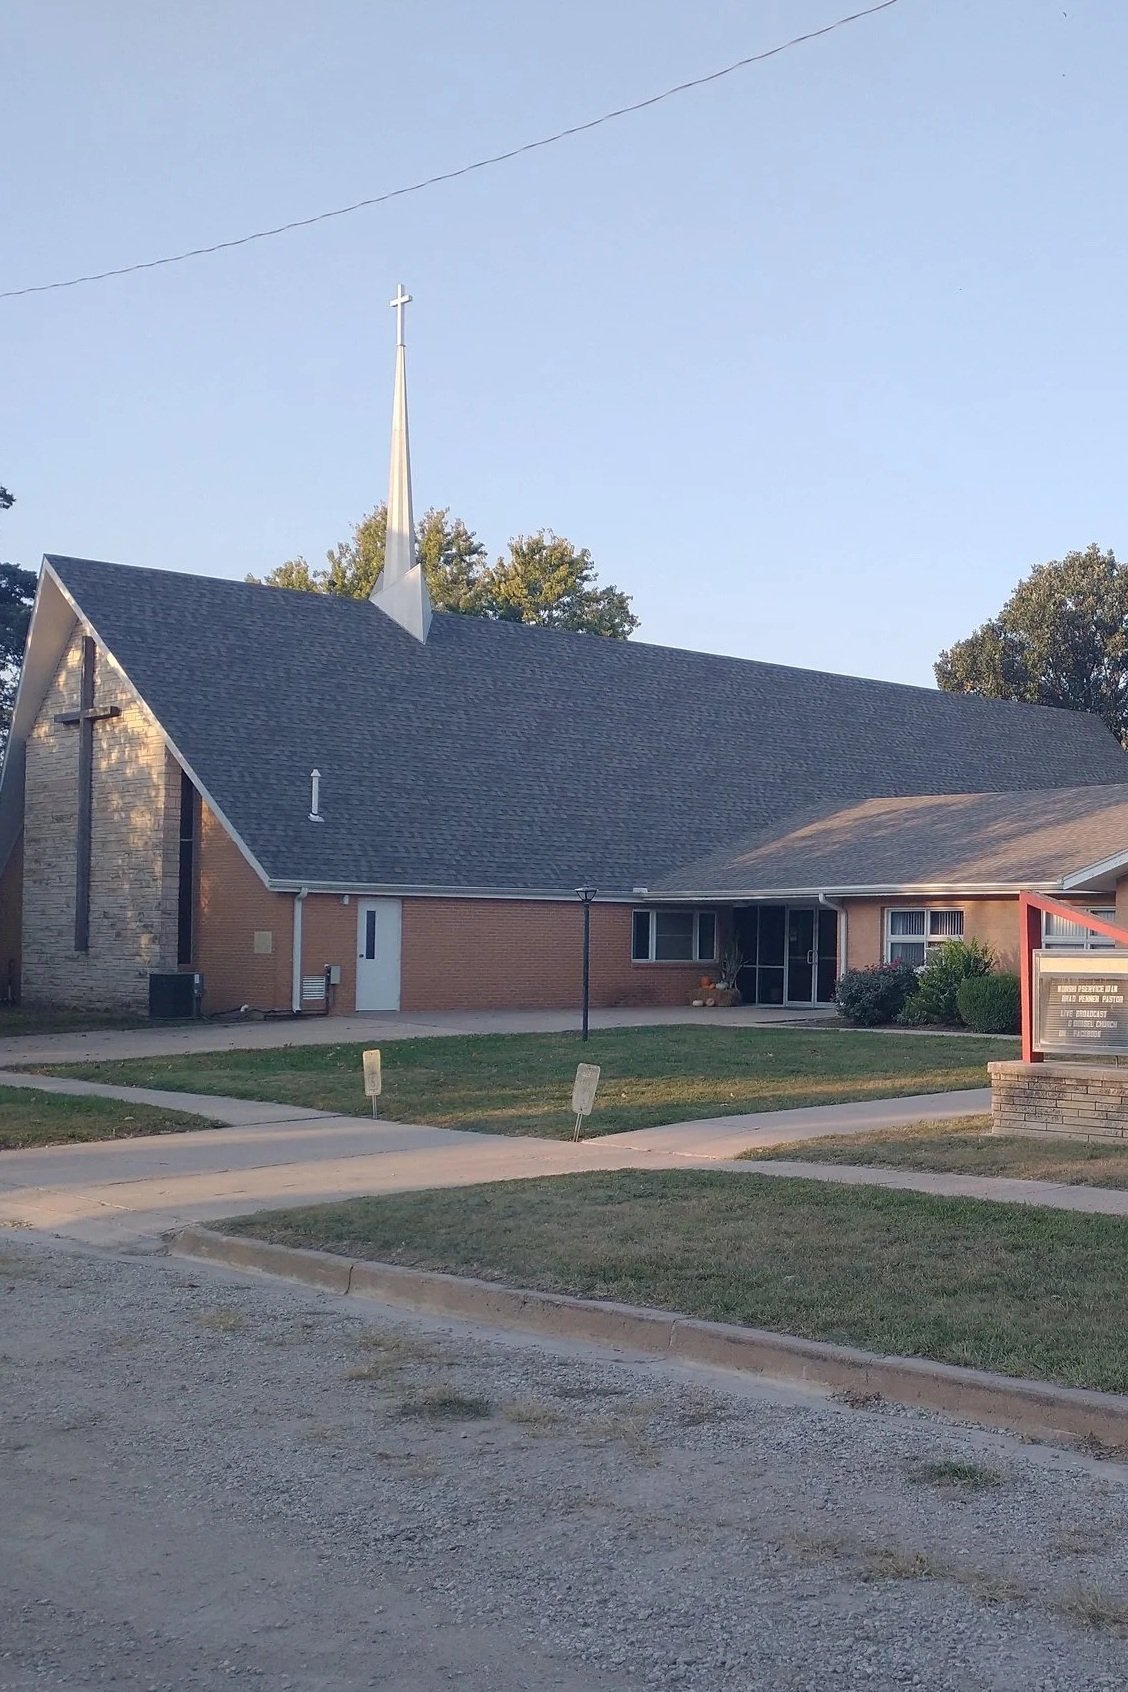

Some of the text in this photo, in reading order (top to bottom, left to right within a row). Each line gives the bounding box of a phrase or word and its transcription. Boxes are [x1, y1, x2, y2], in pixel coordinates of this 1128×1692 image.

[1102, 995, 1124, 1003] PASTOR
[1060, 1010, 1107, 1018] LIVE BROADCAST
[1095, 1020, 1118, 1028] CHURCH
